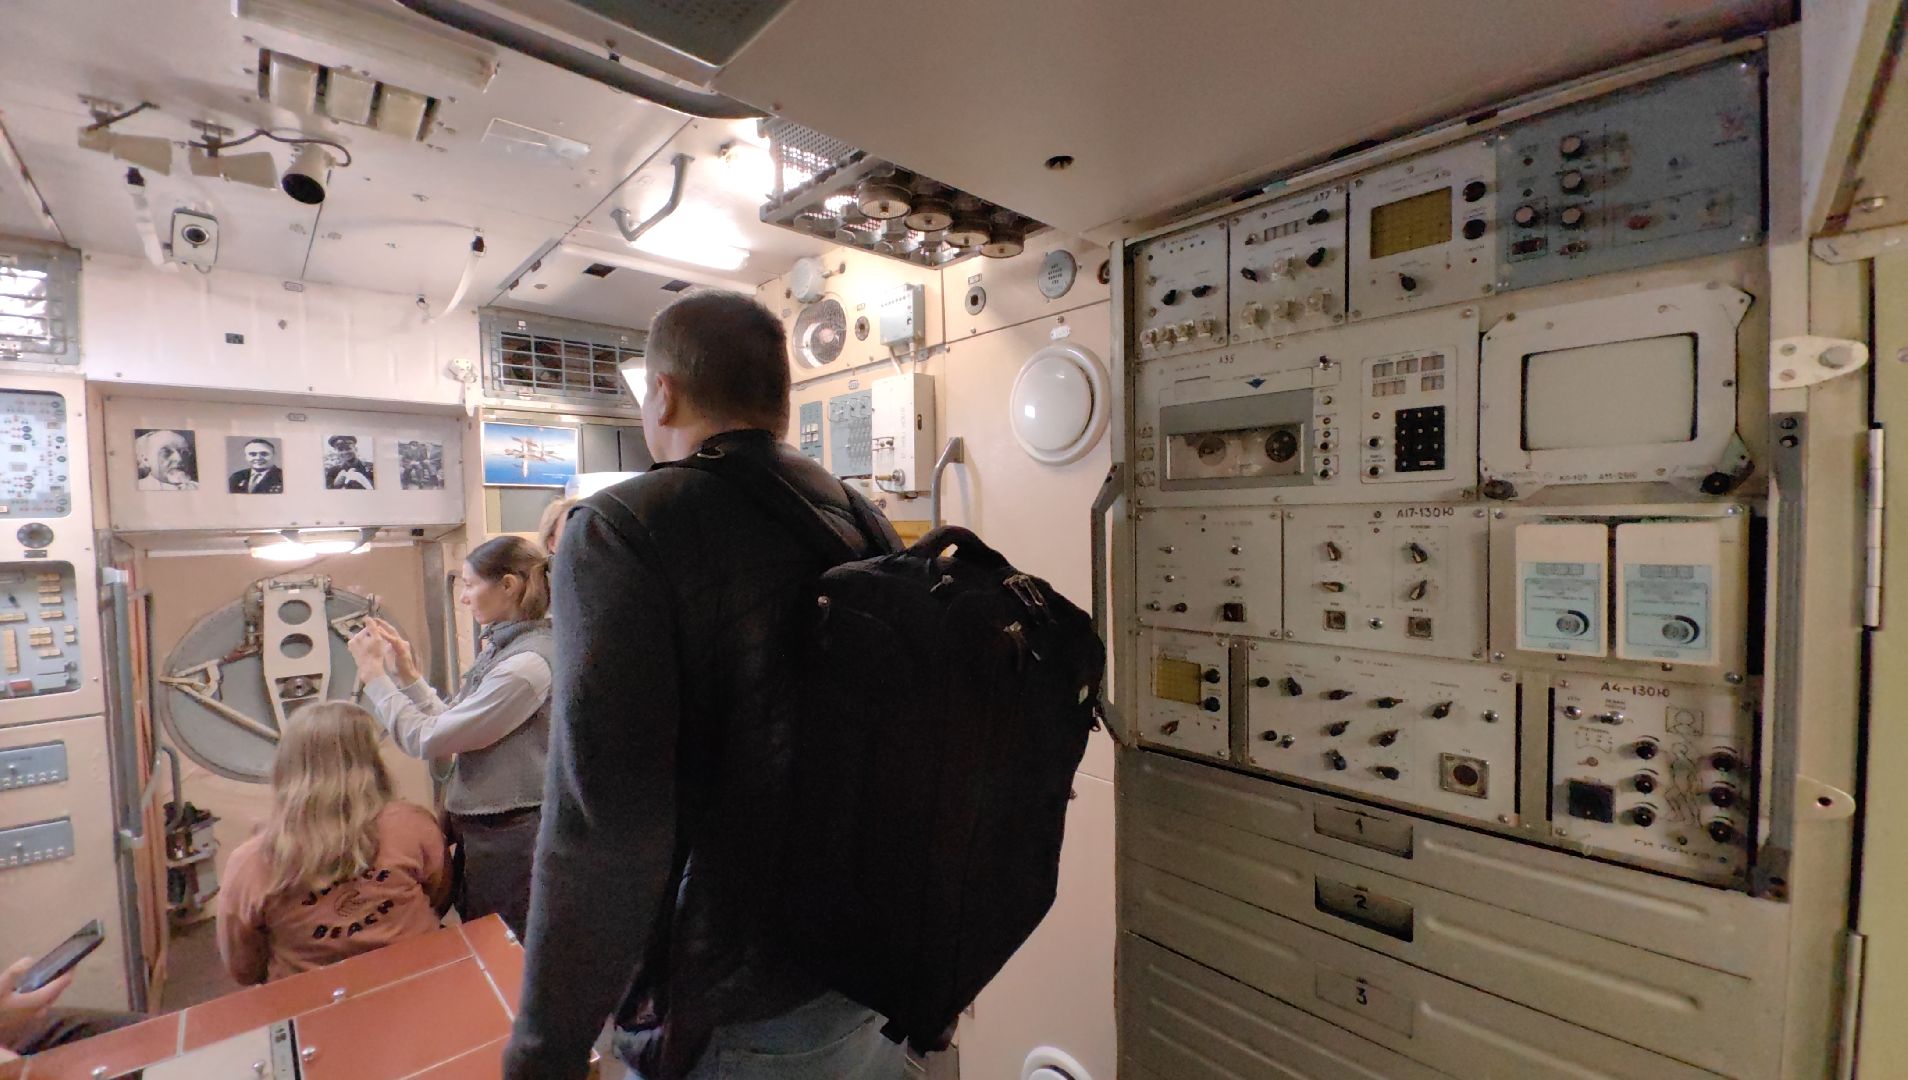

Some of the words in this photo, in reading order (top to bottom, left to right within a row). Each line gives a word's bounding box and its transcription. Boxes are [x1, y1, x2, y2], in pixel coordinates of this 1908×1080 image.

[1352, 893, 1368, 910] 2
[311, 898, 395, 940] BEACH
[1355, 985, 1369, 1006] 3
